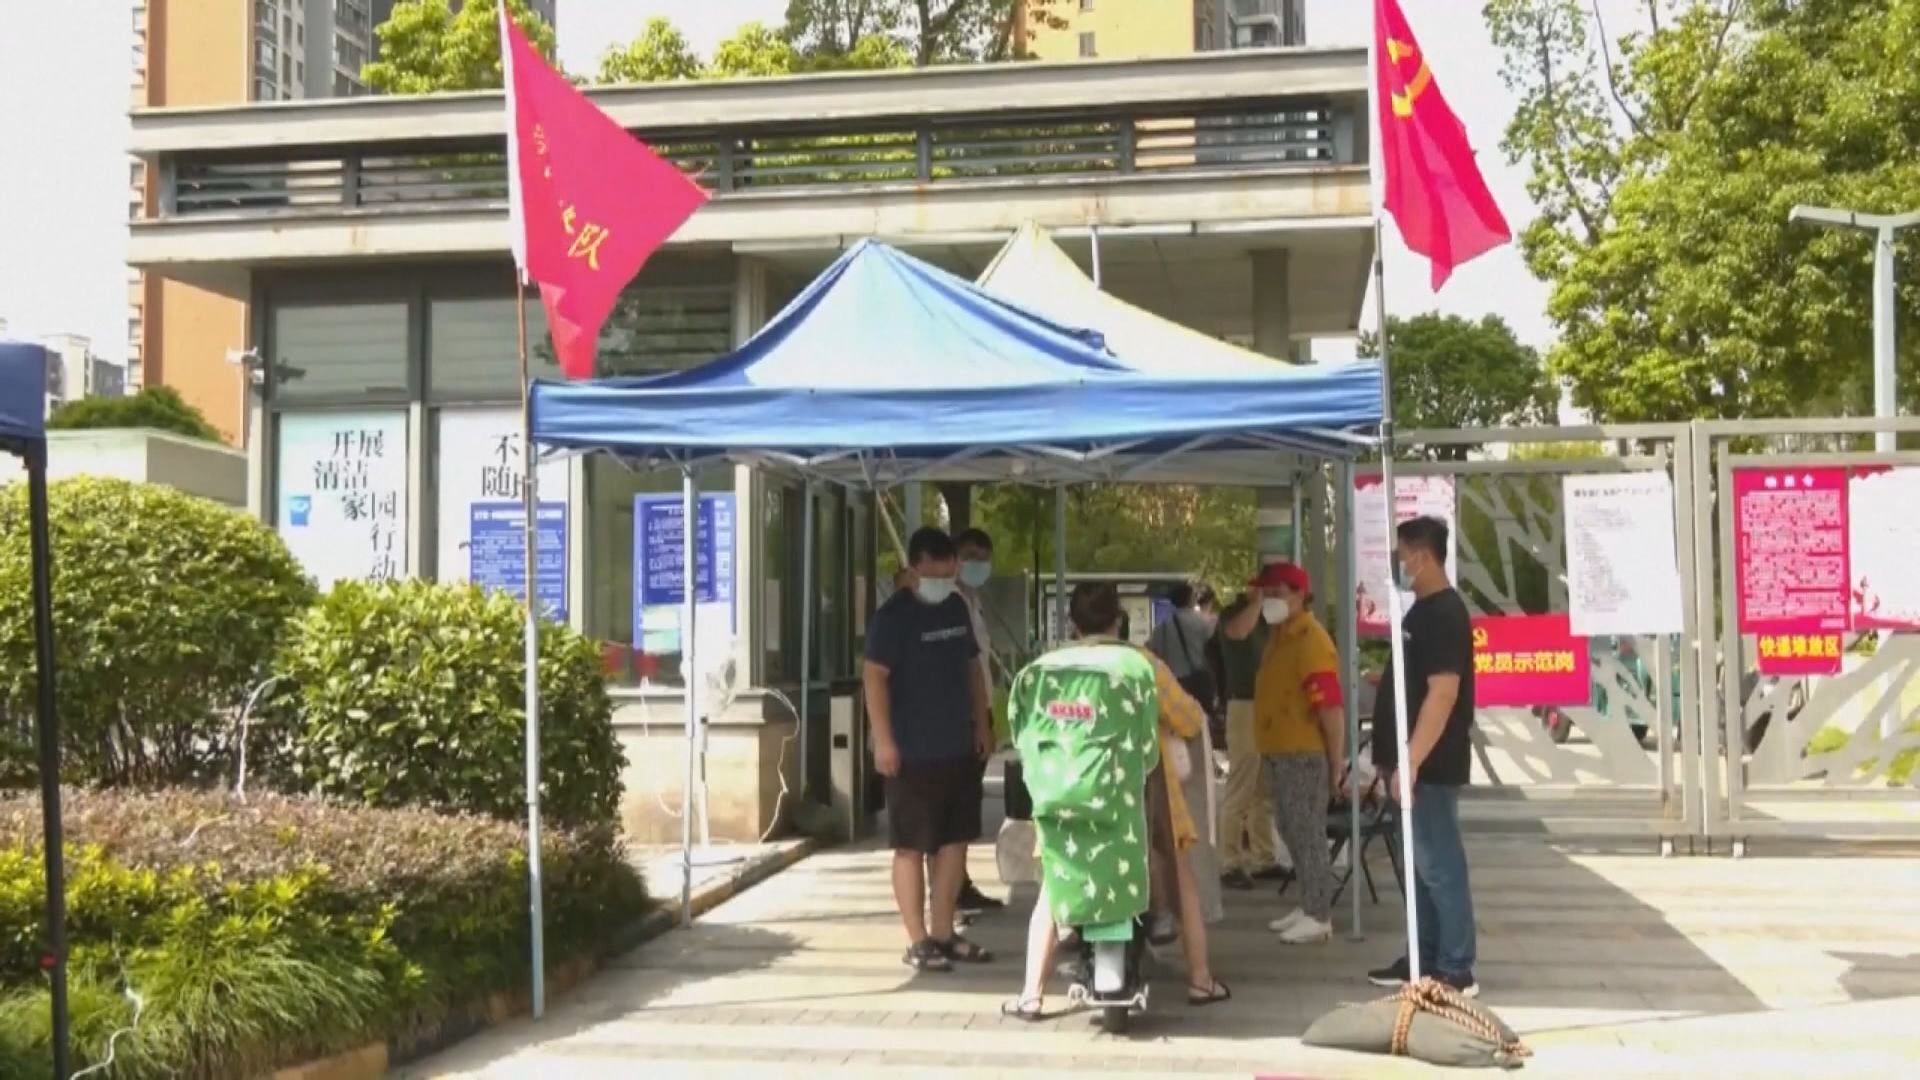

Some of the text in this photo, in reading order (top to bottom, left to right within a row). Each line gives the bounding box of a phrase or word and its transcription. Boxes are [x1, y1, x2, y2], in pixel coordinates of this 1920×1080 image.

[332, 430, 384, 459] 开展
[489, 432, 520, 464] 不
[314, 460, 369, 491] 清洁
[340, 490, 398, 522] 家园
[1474, 651, 1576, 674] 党员示范岗
